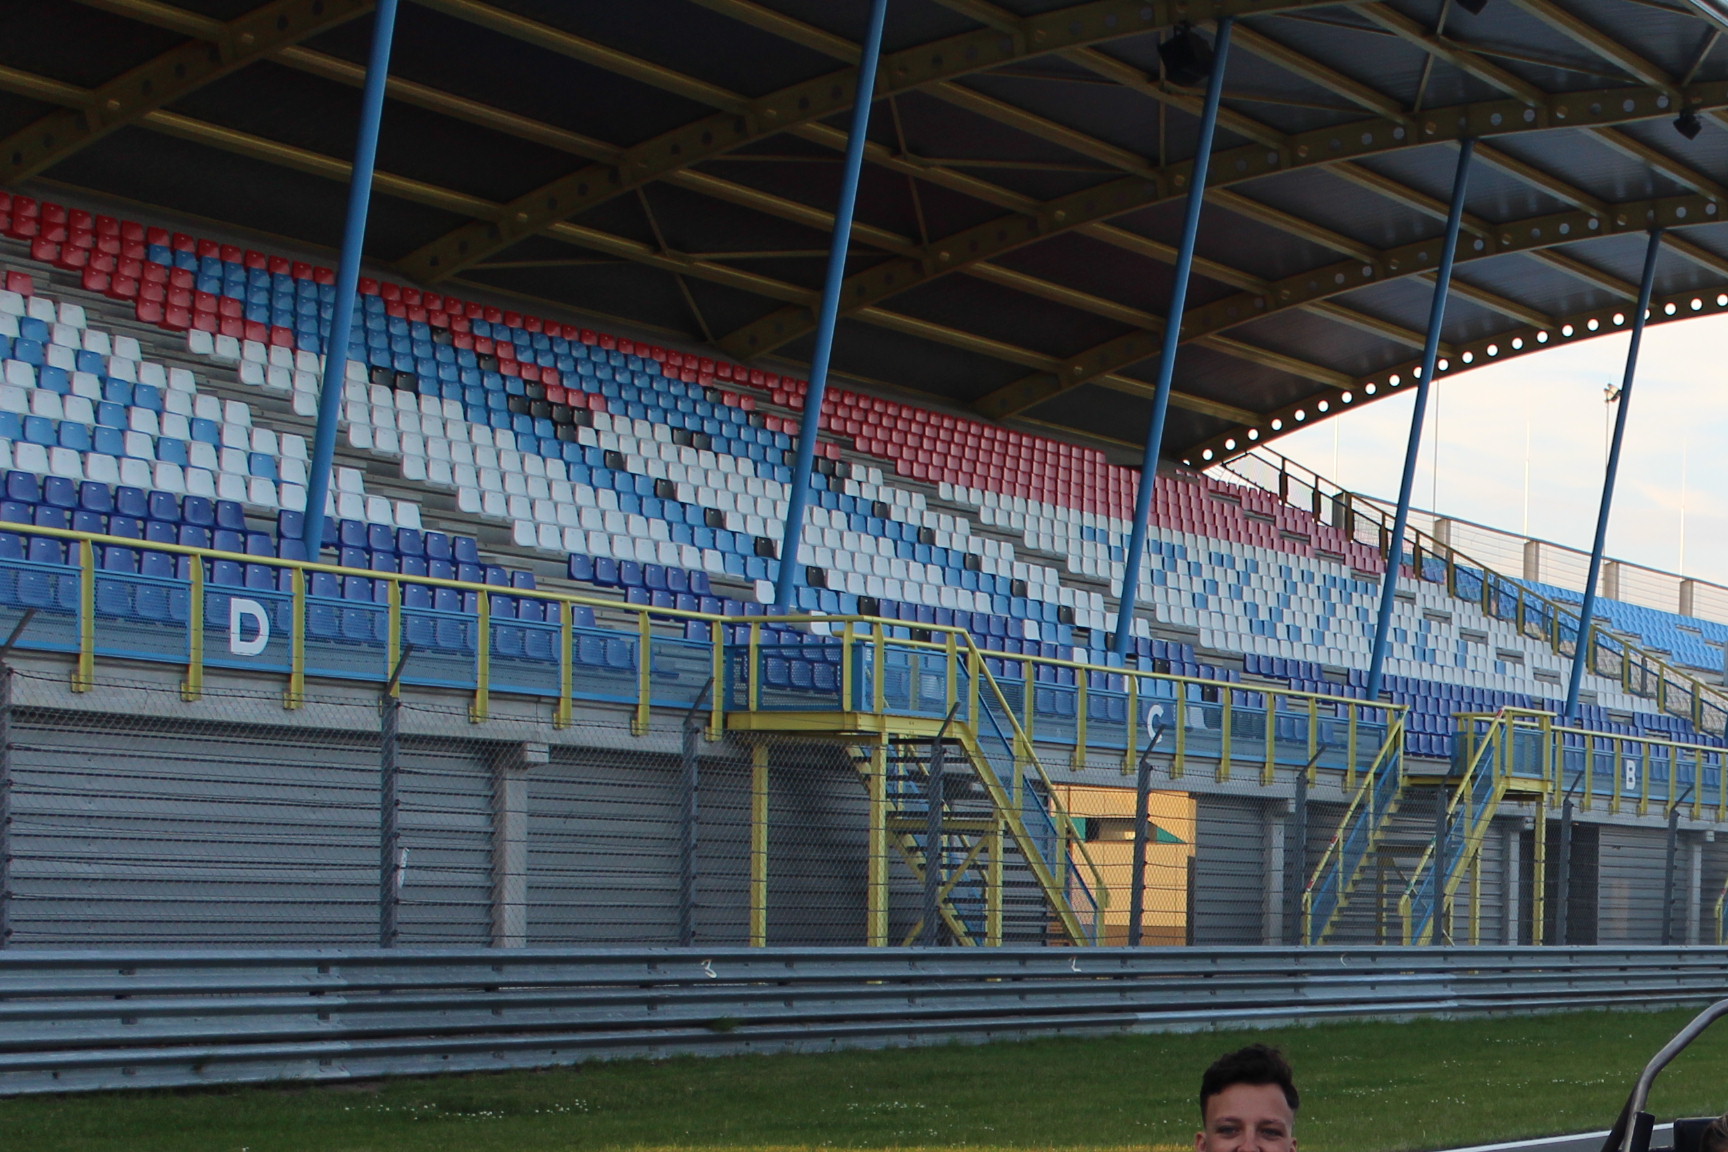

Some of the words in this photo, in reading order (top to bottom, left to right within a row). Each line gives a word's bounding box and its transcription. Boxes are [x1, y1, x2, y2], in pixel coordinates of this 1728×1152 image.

[230, 597, 270, 656] D
[1147, 704, 1164, 744] C
[1626, 760, 1636, 790] B
